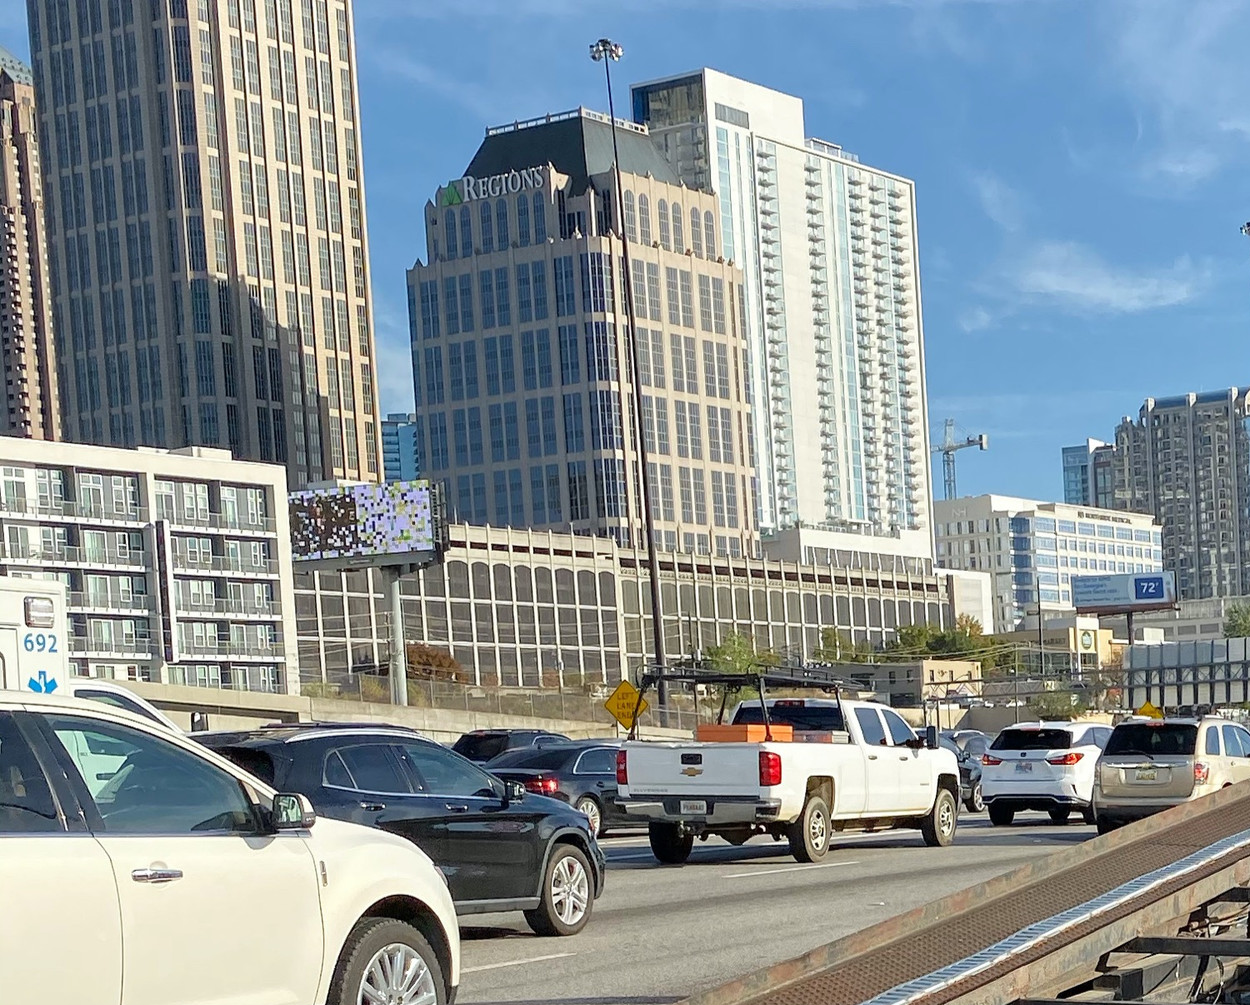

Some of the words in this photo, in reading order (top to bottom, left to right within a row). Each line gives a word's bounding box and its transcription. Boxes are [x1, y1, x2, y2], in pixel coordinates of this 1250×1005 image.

[24, 633, 58, 653] 692
[617, 692, 634, 700] LEFT
[617, 711, 636, 720] END
